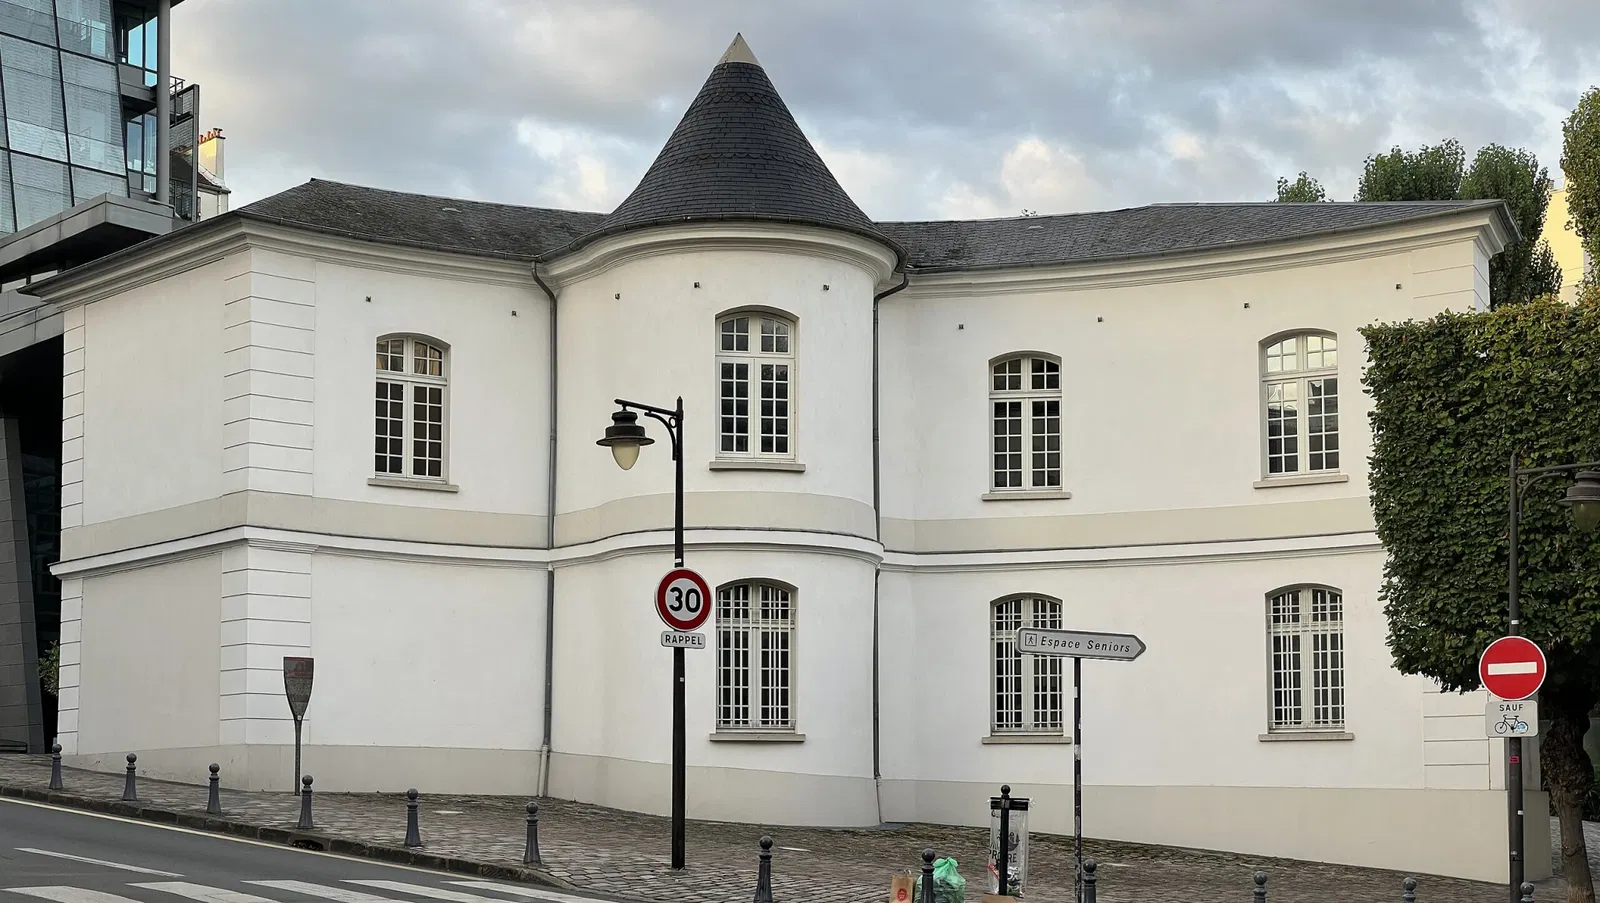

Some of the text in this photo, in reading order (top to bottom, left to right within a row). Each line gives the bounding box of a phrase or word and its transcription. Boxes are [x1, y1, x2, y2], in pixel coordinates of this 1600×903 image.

[668, 586, 701, 613] 30
[665, 634, 703, 645] RAPPEL
[1040, 636, 1131, 652] Espace Seniors
[1499, 703, 1524, 711] SAUF
